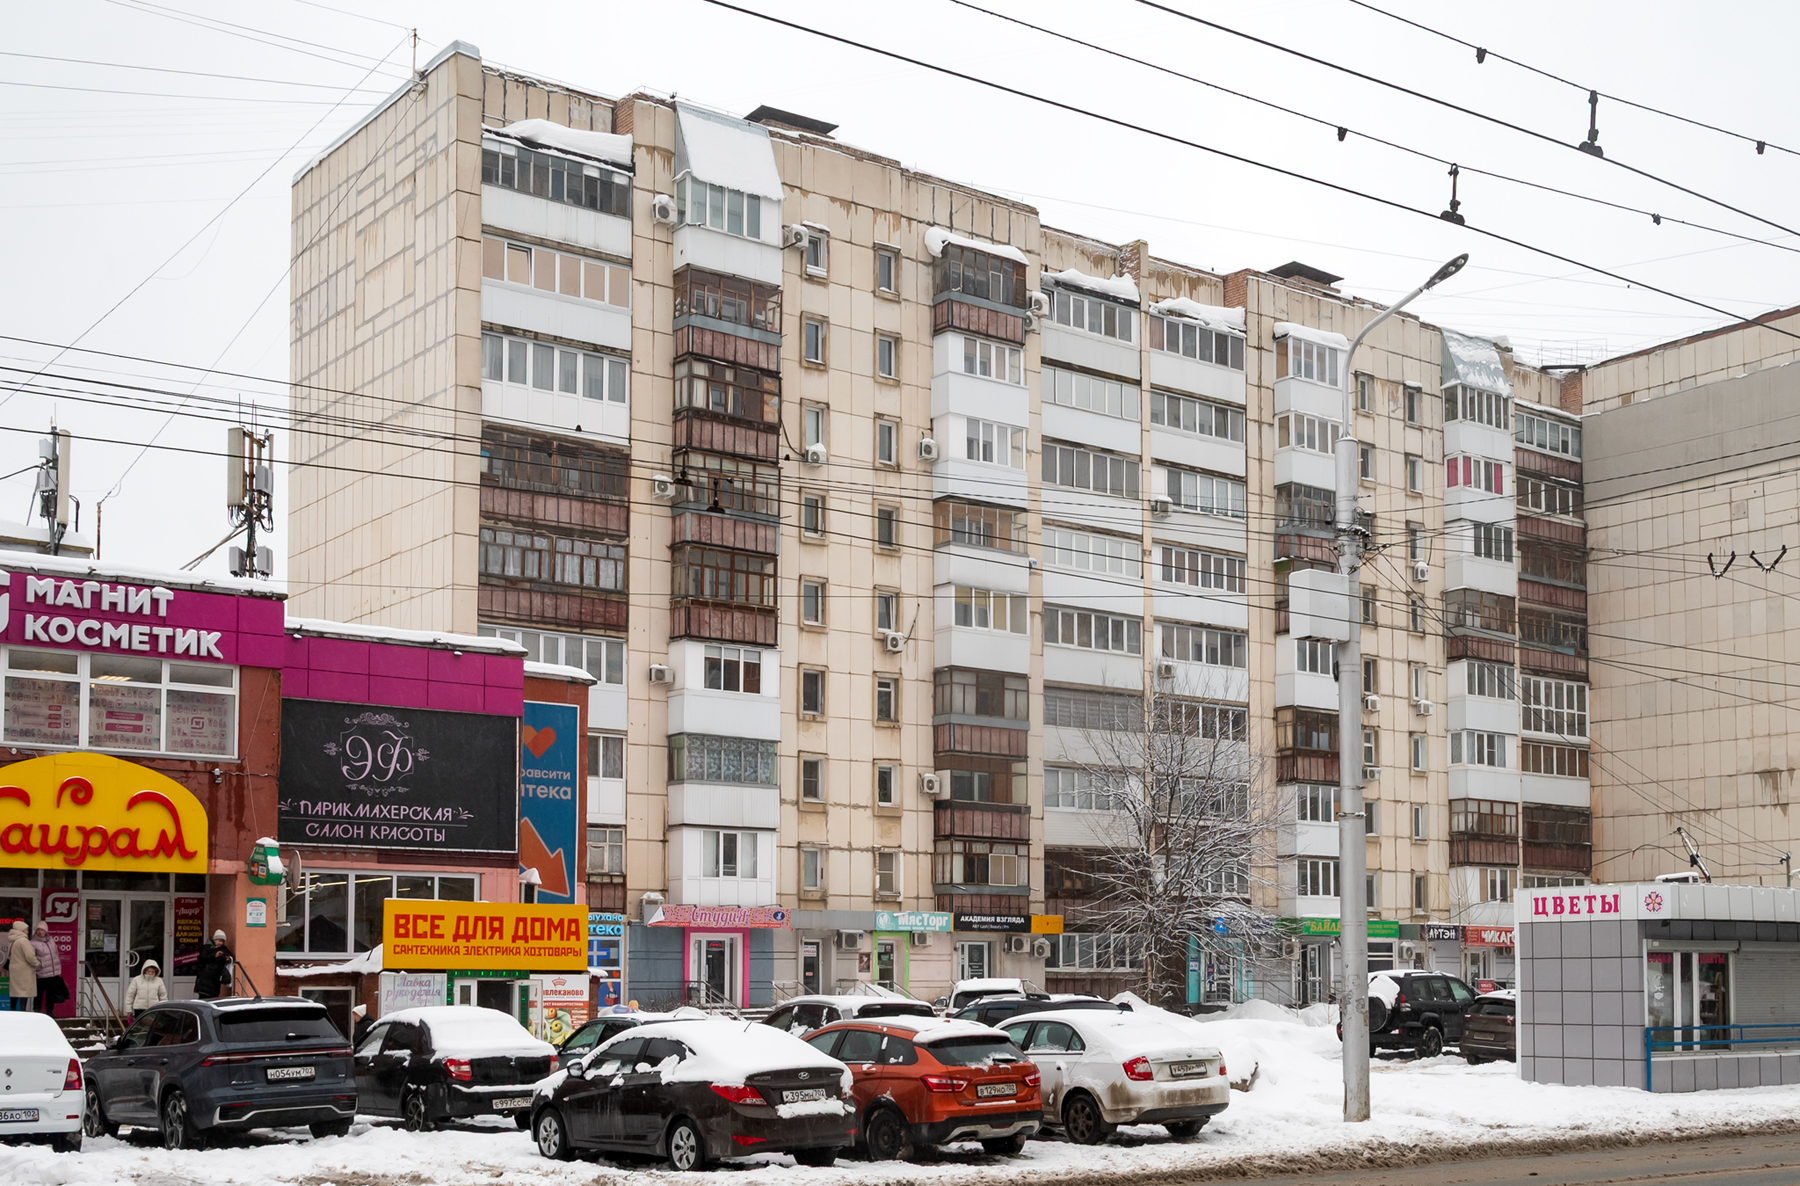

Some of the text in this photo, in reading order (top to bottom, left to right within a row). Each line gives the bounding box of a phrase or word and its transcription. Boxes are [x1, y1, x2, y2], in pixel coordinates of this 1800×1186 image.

[26, 575, 174, 617] МАГНИТ
[24, 613, 224, 659] КОСМЕТИК
[299, 800, 453, 822] ПАРИКМАХЕРСКАЯ
[0, 776, 198, 867] айрам
[305, 822, 446, 842] САЛОН КРАСОТЫ
[1533, 894, 1620, 918] ЦВЕТЫ
[898, 913, 949, 931] МясТорг
[960, 915, 1025, 924] АКАДЕМИЯ ВЗГЛЯДА
[394, 914, 581, 944] ВСЕ ДЛЯ ДОМА
[1429, 928, 1456, 940] АРТЭН
[393, 945, 582, 958] САНТЕХНИКА ЭЛЕКТРИКА ХОЗТОВАРЫ
[397, 976, 431, 988] Лавка
[534, 987, 584, 997] влеканово
[270, 1068, 300, 1078] Н054УМ
[494, 1100, 521, 1108] Е997СС
